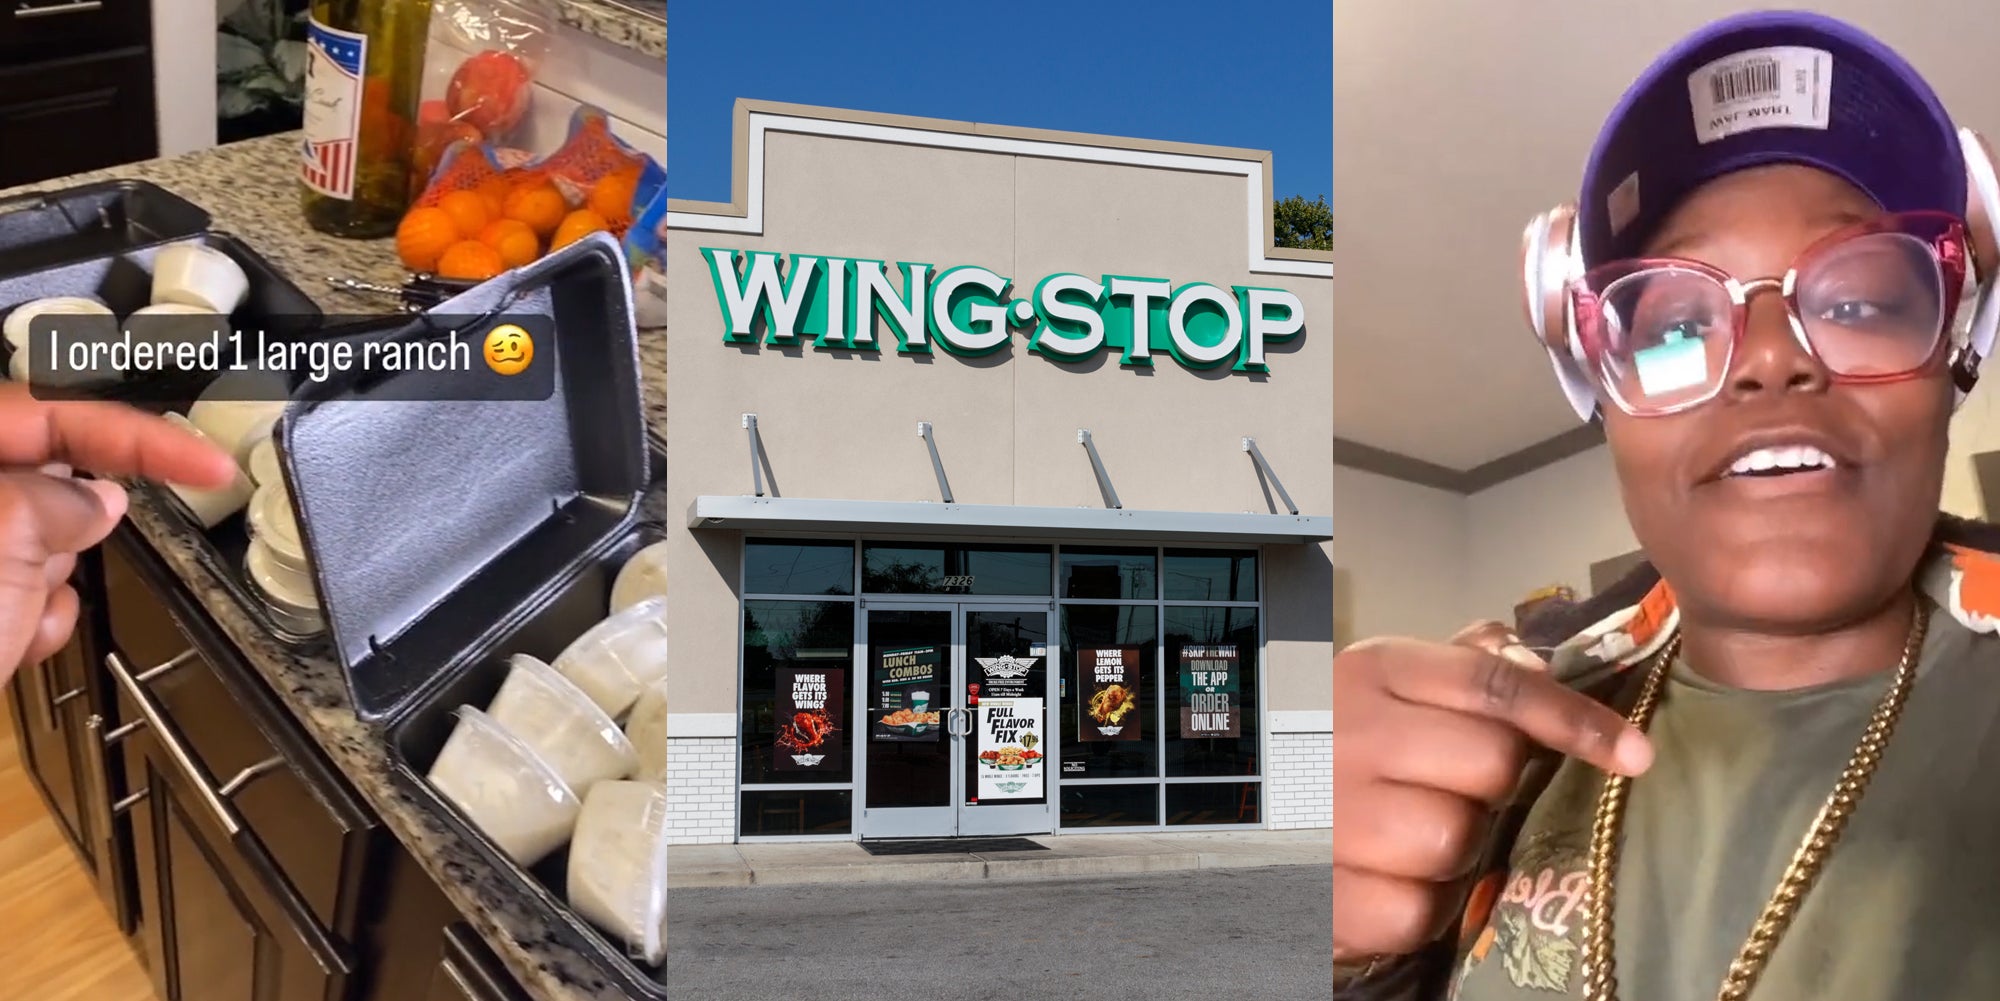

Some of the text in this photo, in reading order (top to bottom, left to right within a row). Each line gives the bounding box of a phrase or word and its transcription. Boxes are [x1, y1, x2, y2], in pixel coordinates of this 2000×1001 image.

[944, 576, 974, 586] 7326
[1095, 649, 1122, 658] WHERE
[883, 655, 917, 669] LUNCH
[1096, 657, 1122, 666] LEMON
[1191, 660, 1228, 671] DOWNLOAD
[889, 664, 933, 678] COMBOS
[1094, 665, 1125, 674] GETS ITS
[795, 674, 826, 683] WHERE
[1095, 674, 1123, 683] PEPPER
[1191, 671, 1228, 686] THE APP
[793, 683, 827, 692] FLAVOR
[792, 692, 828, 700] GETS ITS
[795, 700, 825, 710] WINGS
[1191, 693, 1230, 713] ORDER
[987, 707, 1014, 724] FULL
[990, 718, 1035, 735] FLAVOR
[1191, 713, 1230, 731] ONLINE
[994, 730, 1018, 744] FIX
